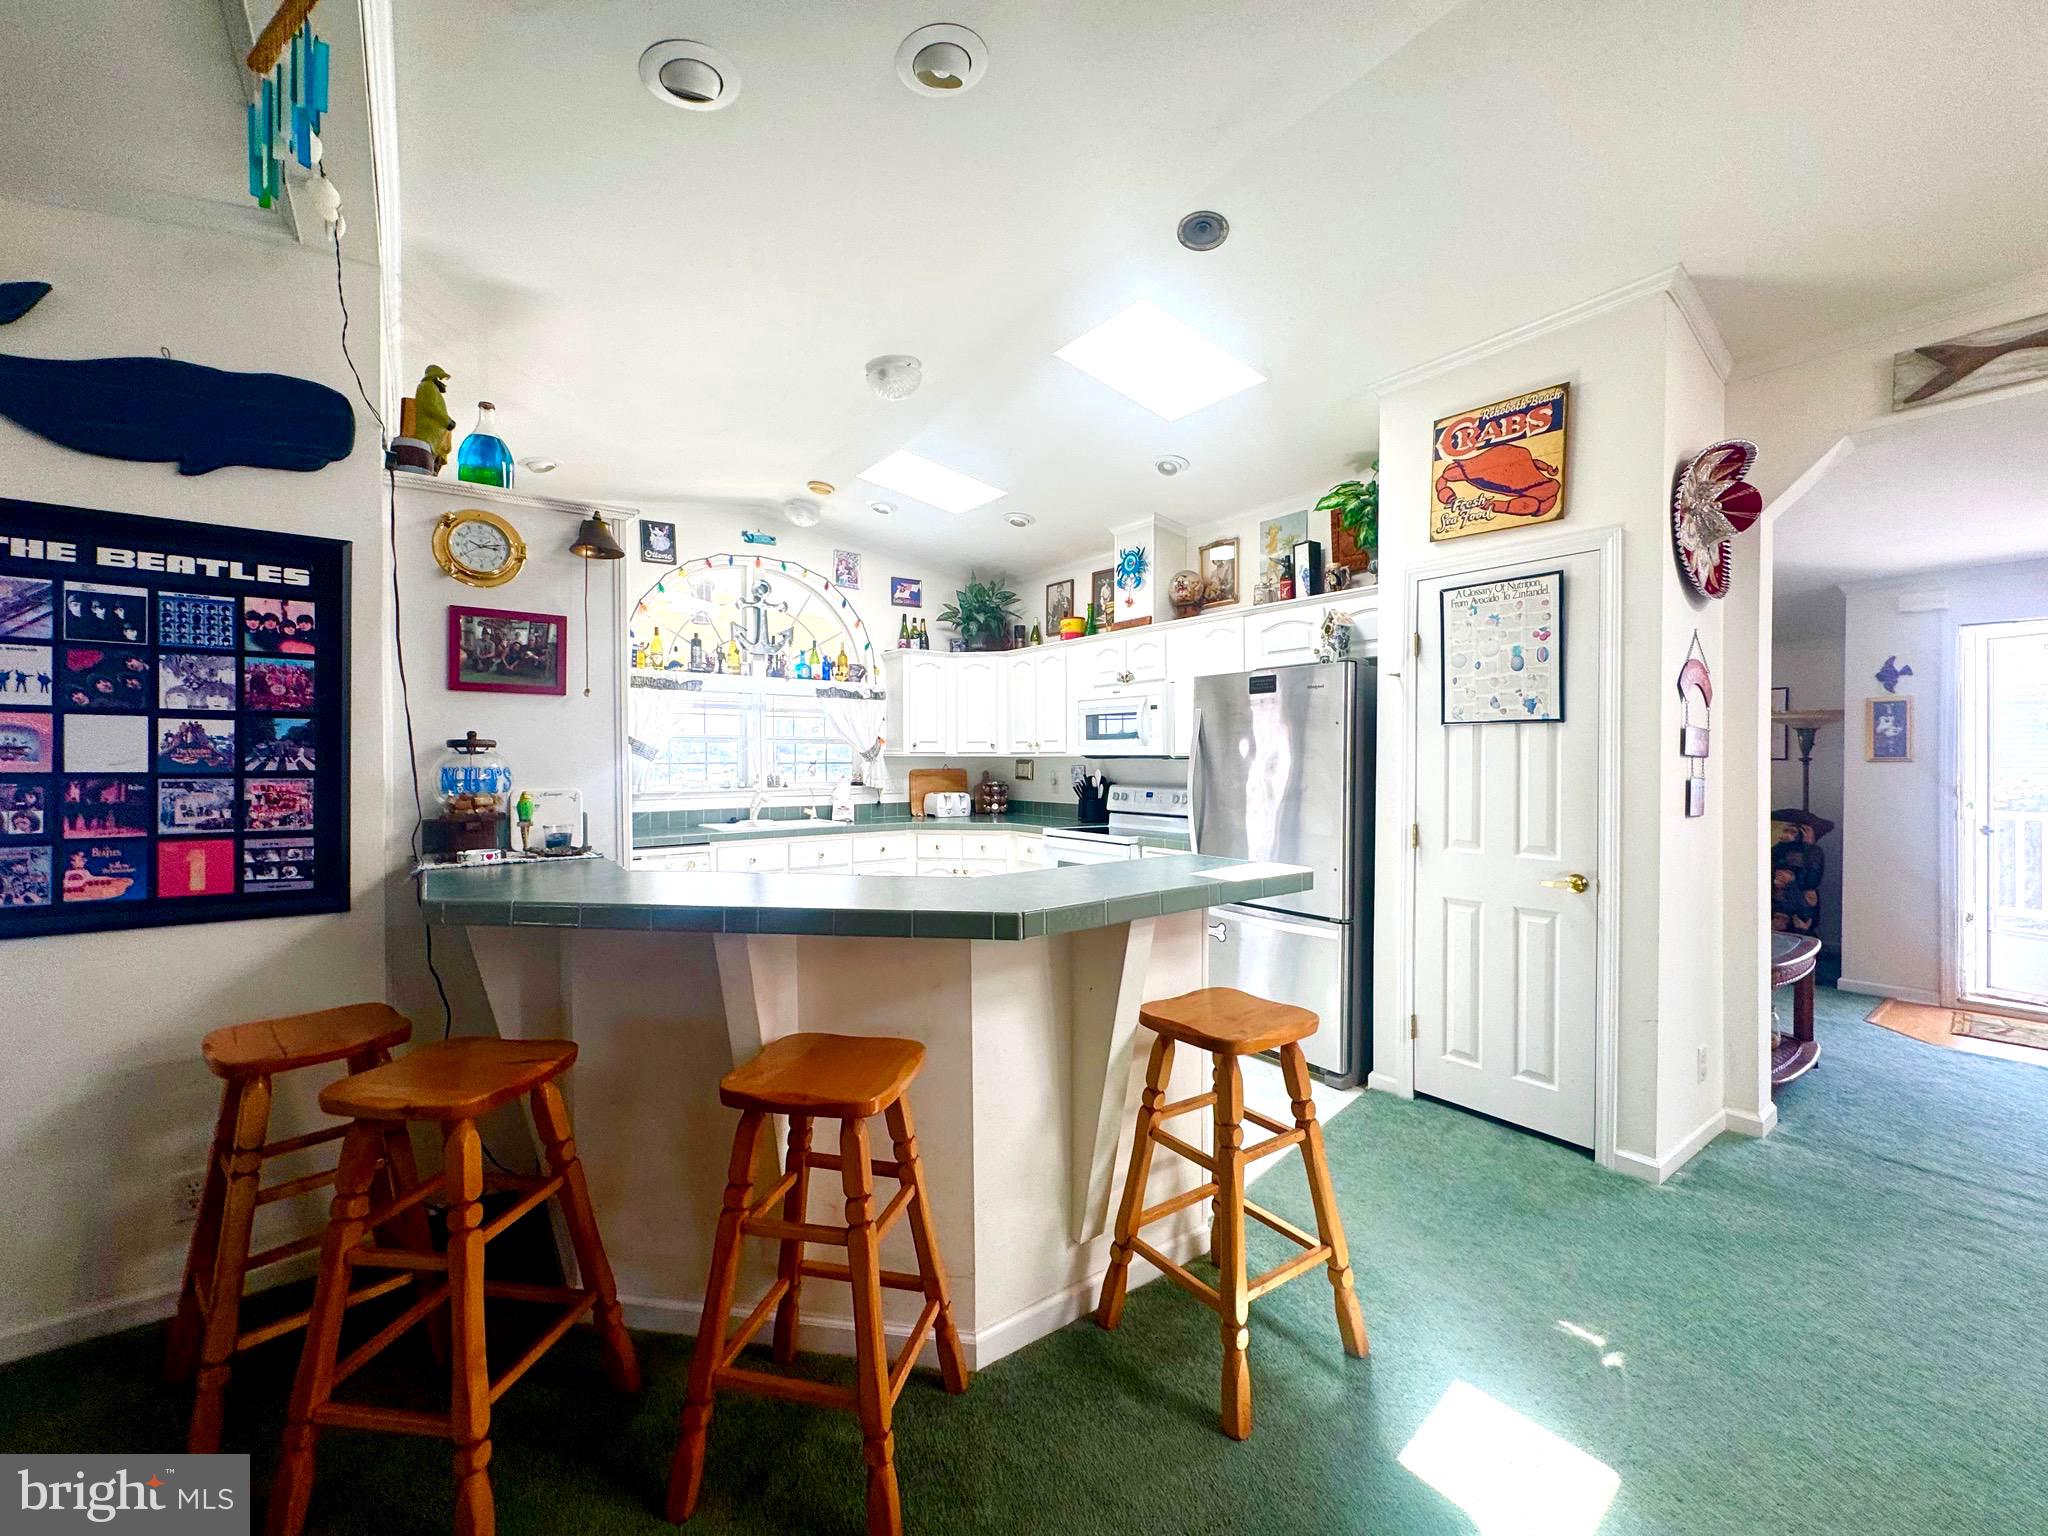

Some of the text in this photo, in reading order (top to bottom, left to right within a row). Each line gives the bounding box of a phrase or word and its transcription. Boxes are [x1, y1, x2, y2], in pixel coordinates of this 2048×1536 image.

[1529, 388, 1562, 407] Beach
[1436, 403, 1553, 460] CRABS
[1450, 493, 1488, 513] Fresh
[1459, 503, 1495, 529] Food
[0, 536, 310, 587] HE BEATLES
[1451, 599, 1469, 608] From
[1471, 593, 1500, 605] Avocado
[1502, 591, 1511, 601] To
[1456, 590, 1463, 599] A
[1462, 587, 1493, 598] Glossary
[1494, 583, 1505, 593] Of
[441, 766, 512, 794] NUTS
[186, 848, 206, 891] 1
